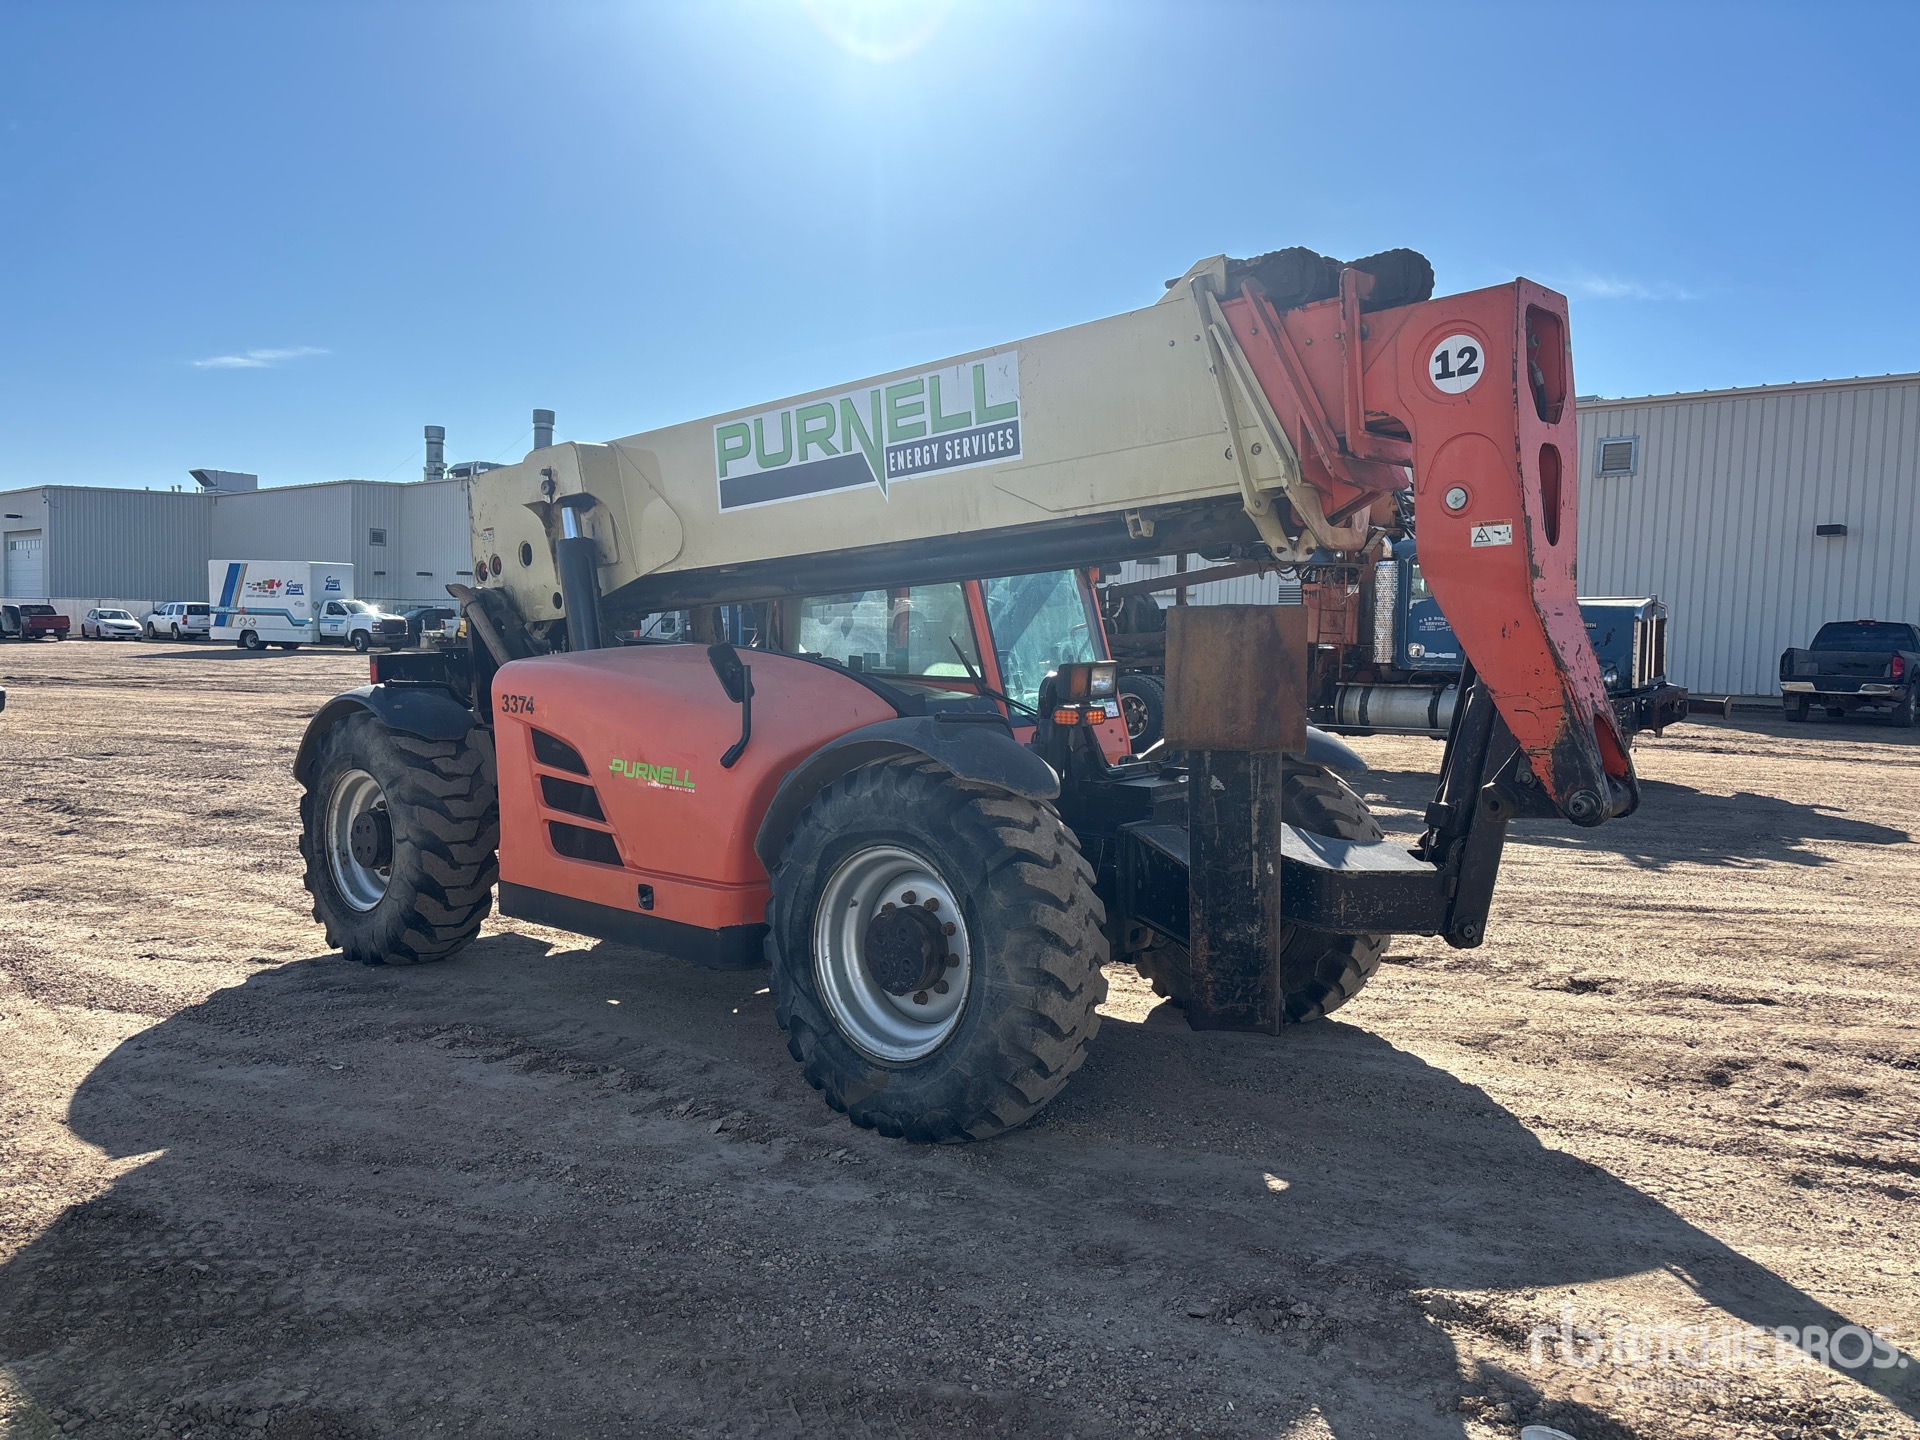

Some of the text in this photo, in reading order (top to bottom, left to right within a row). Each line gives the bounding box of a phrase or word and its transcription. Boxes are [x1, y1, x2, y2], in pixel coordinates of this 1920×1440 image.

[1435, 346, 1478, 380] 12
[715, 363, 1018, 497] PURNELL
[889, 428, 1014, 472] ENERGY SERVICES
[502, 694, 534, 714] 3374
[608, 758, 696, 788] PURNELL
[668, 785, 696, 793] SERVICES
